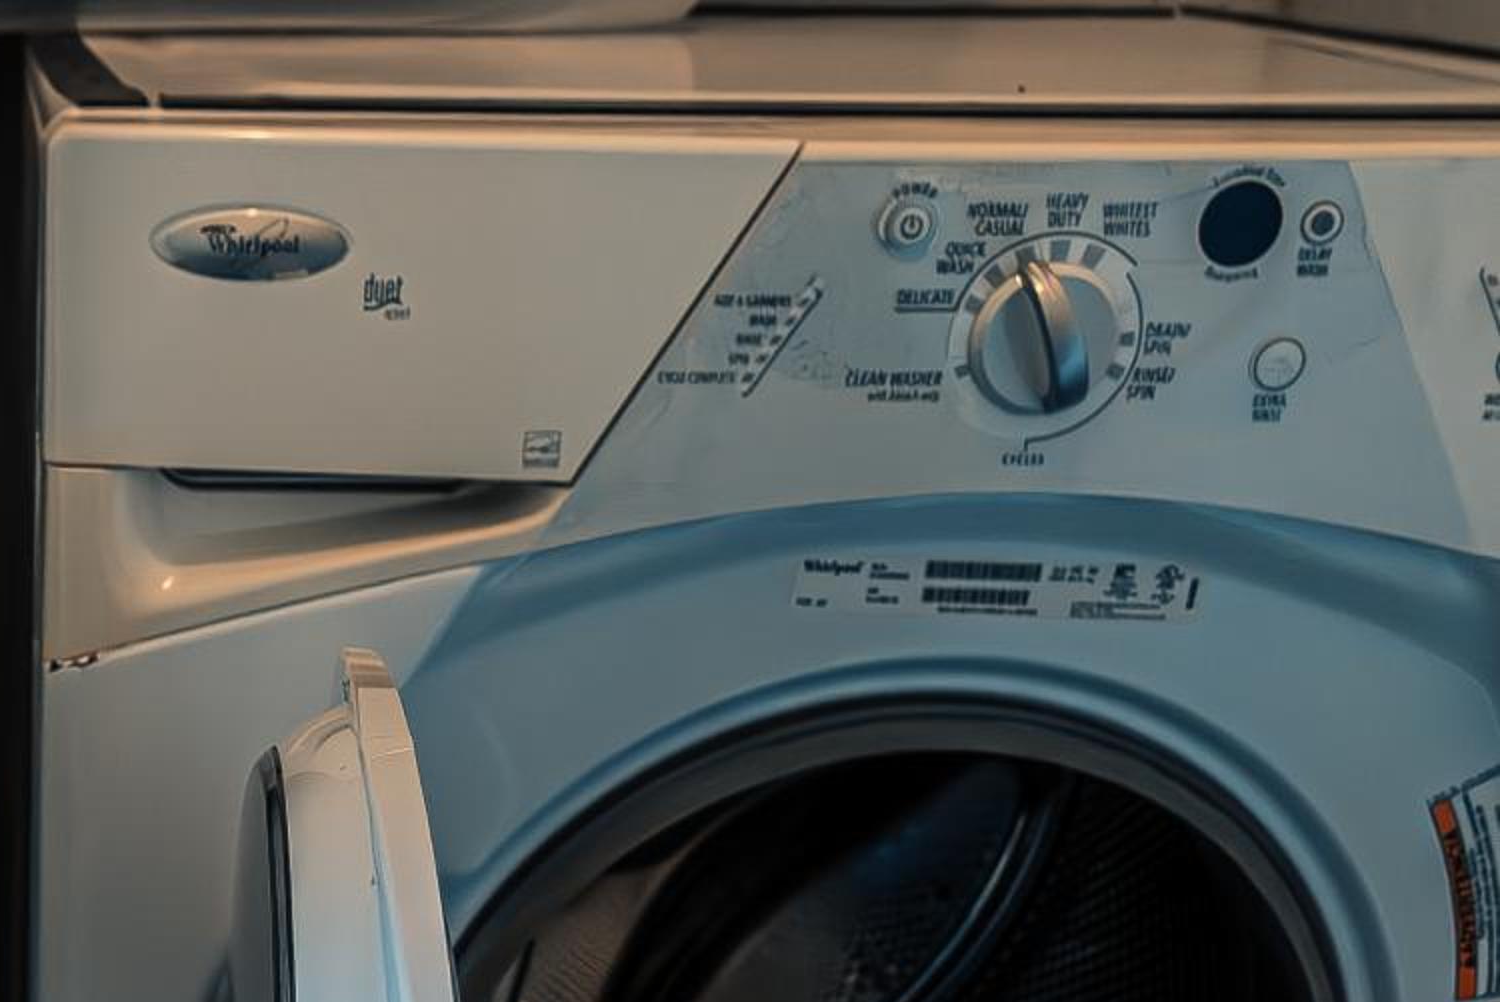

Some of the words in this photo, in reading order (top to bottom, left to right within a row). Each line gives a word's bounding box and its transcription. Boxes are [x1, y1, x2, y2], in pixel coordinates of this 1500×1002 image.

[1047, 192, 1089, 209] HEAVY
[1048, 210, 1081, 227] DUTY
[1103, 201, 1158, 219] WHITEST
[975, 220, 1025, 236] CASUAL
[1104, 220, 1150, 237] WHITES
[200, 222, 301, 258] Whirlpool
[936, 258, 976, 274] WASH
[363, 272, 404, 311] duet
[896, 288, 956, 305] DELICATE
[845, 370, 888, 387] CLEAN
[889, 370, 943, 387] WASHER
[803, 559, 866, 577] Whirlpool
